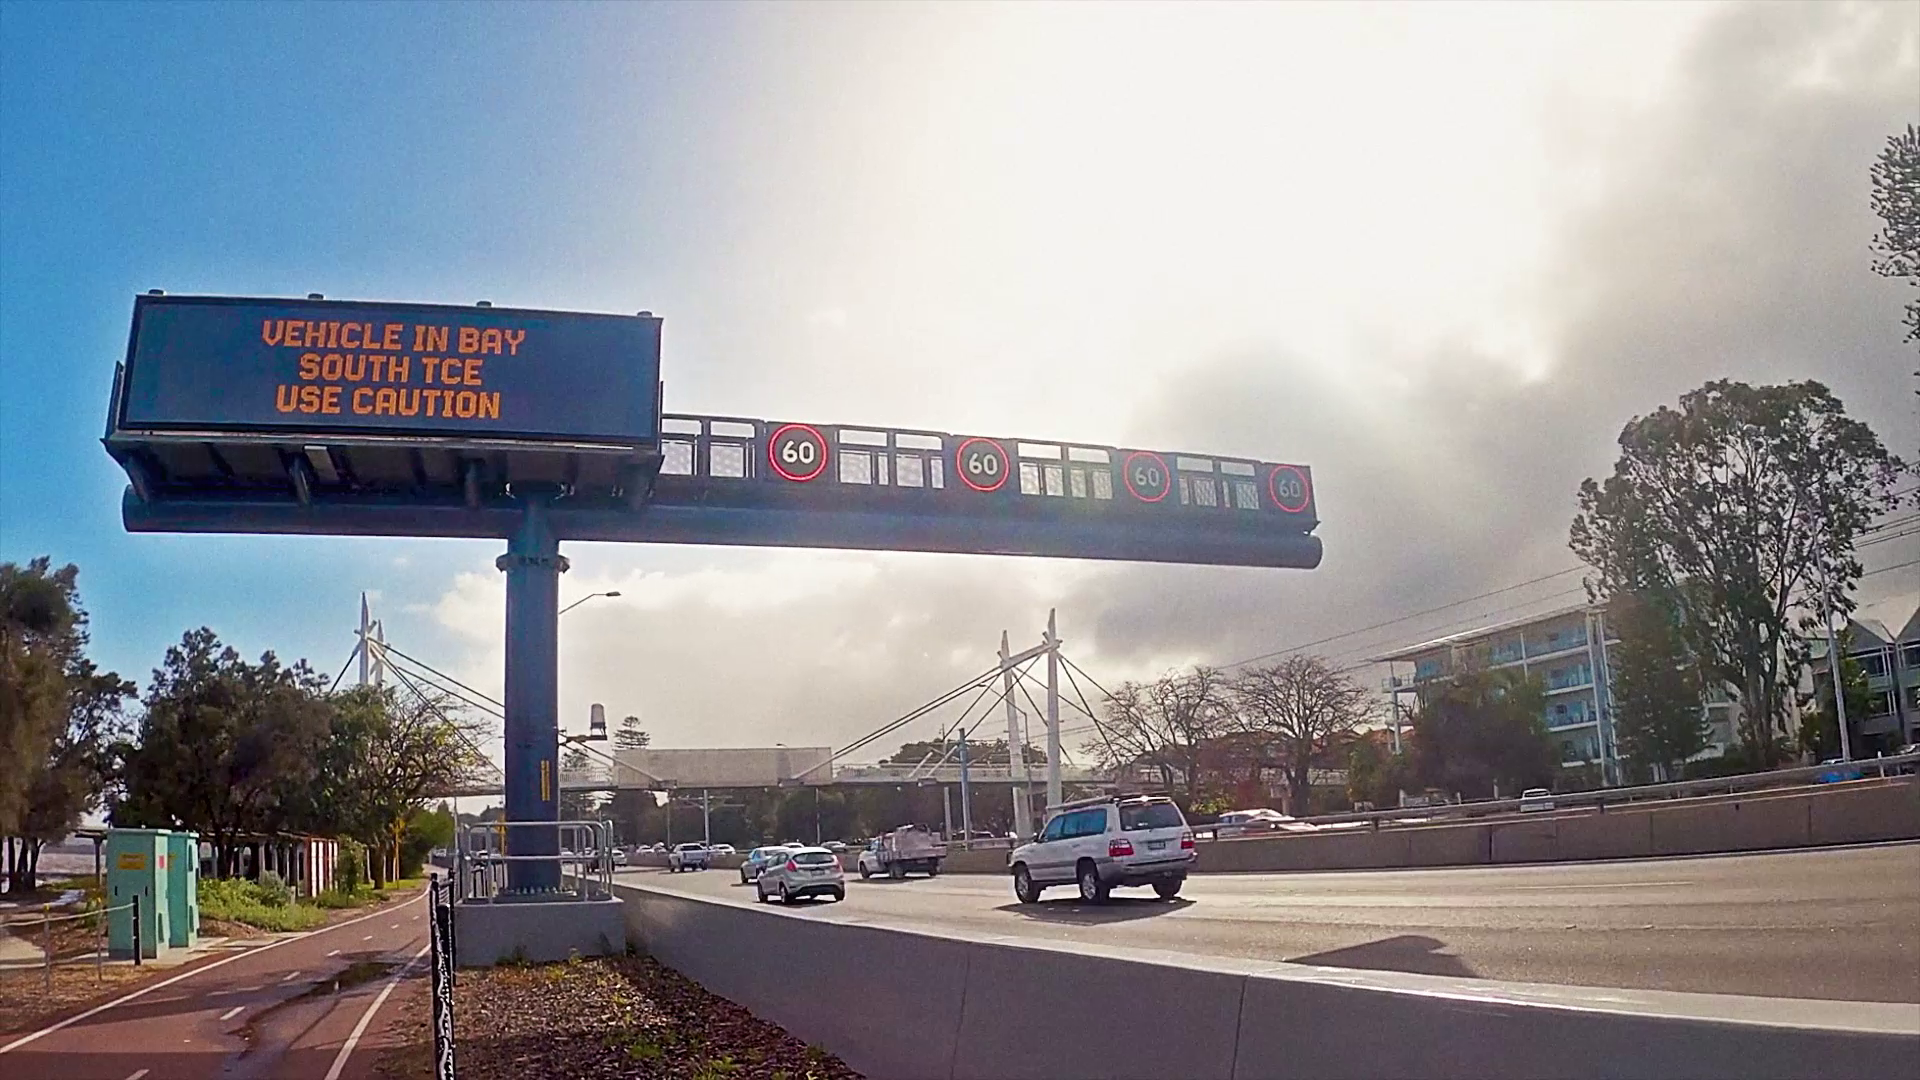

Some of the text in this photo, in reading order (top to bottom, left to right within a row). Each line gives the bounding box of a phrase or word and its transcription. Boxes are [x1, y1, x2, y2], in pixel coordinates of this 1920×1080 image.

[262, 320, 526, 356] VEHICLE IN BAY
[299, 353, 483, 385] SOUTH TCE
[276, 385, 500, 418] USE CAUTION
[781, 440, 815, 465] 60
[967, 452, 998, 476] 60
[1134, 465, 1160, 488] 60
[1278, 478, 1301, 499] 60
